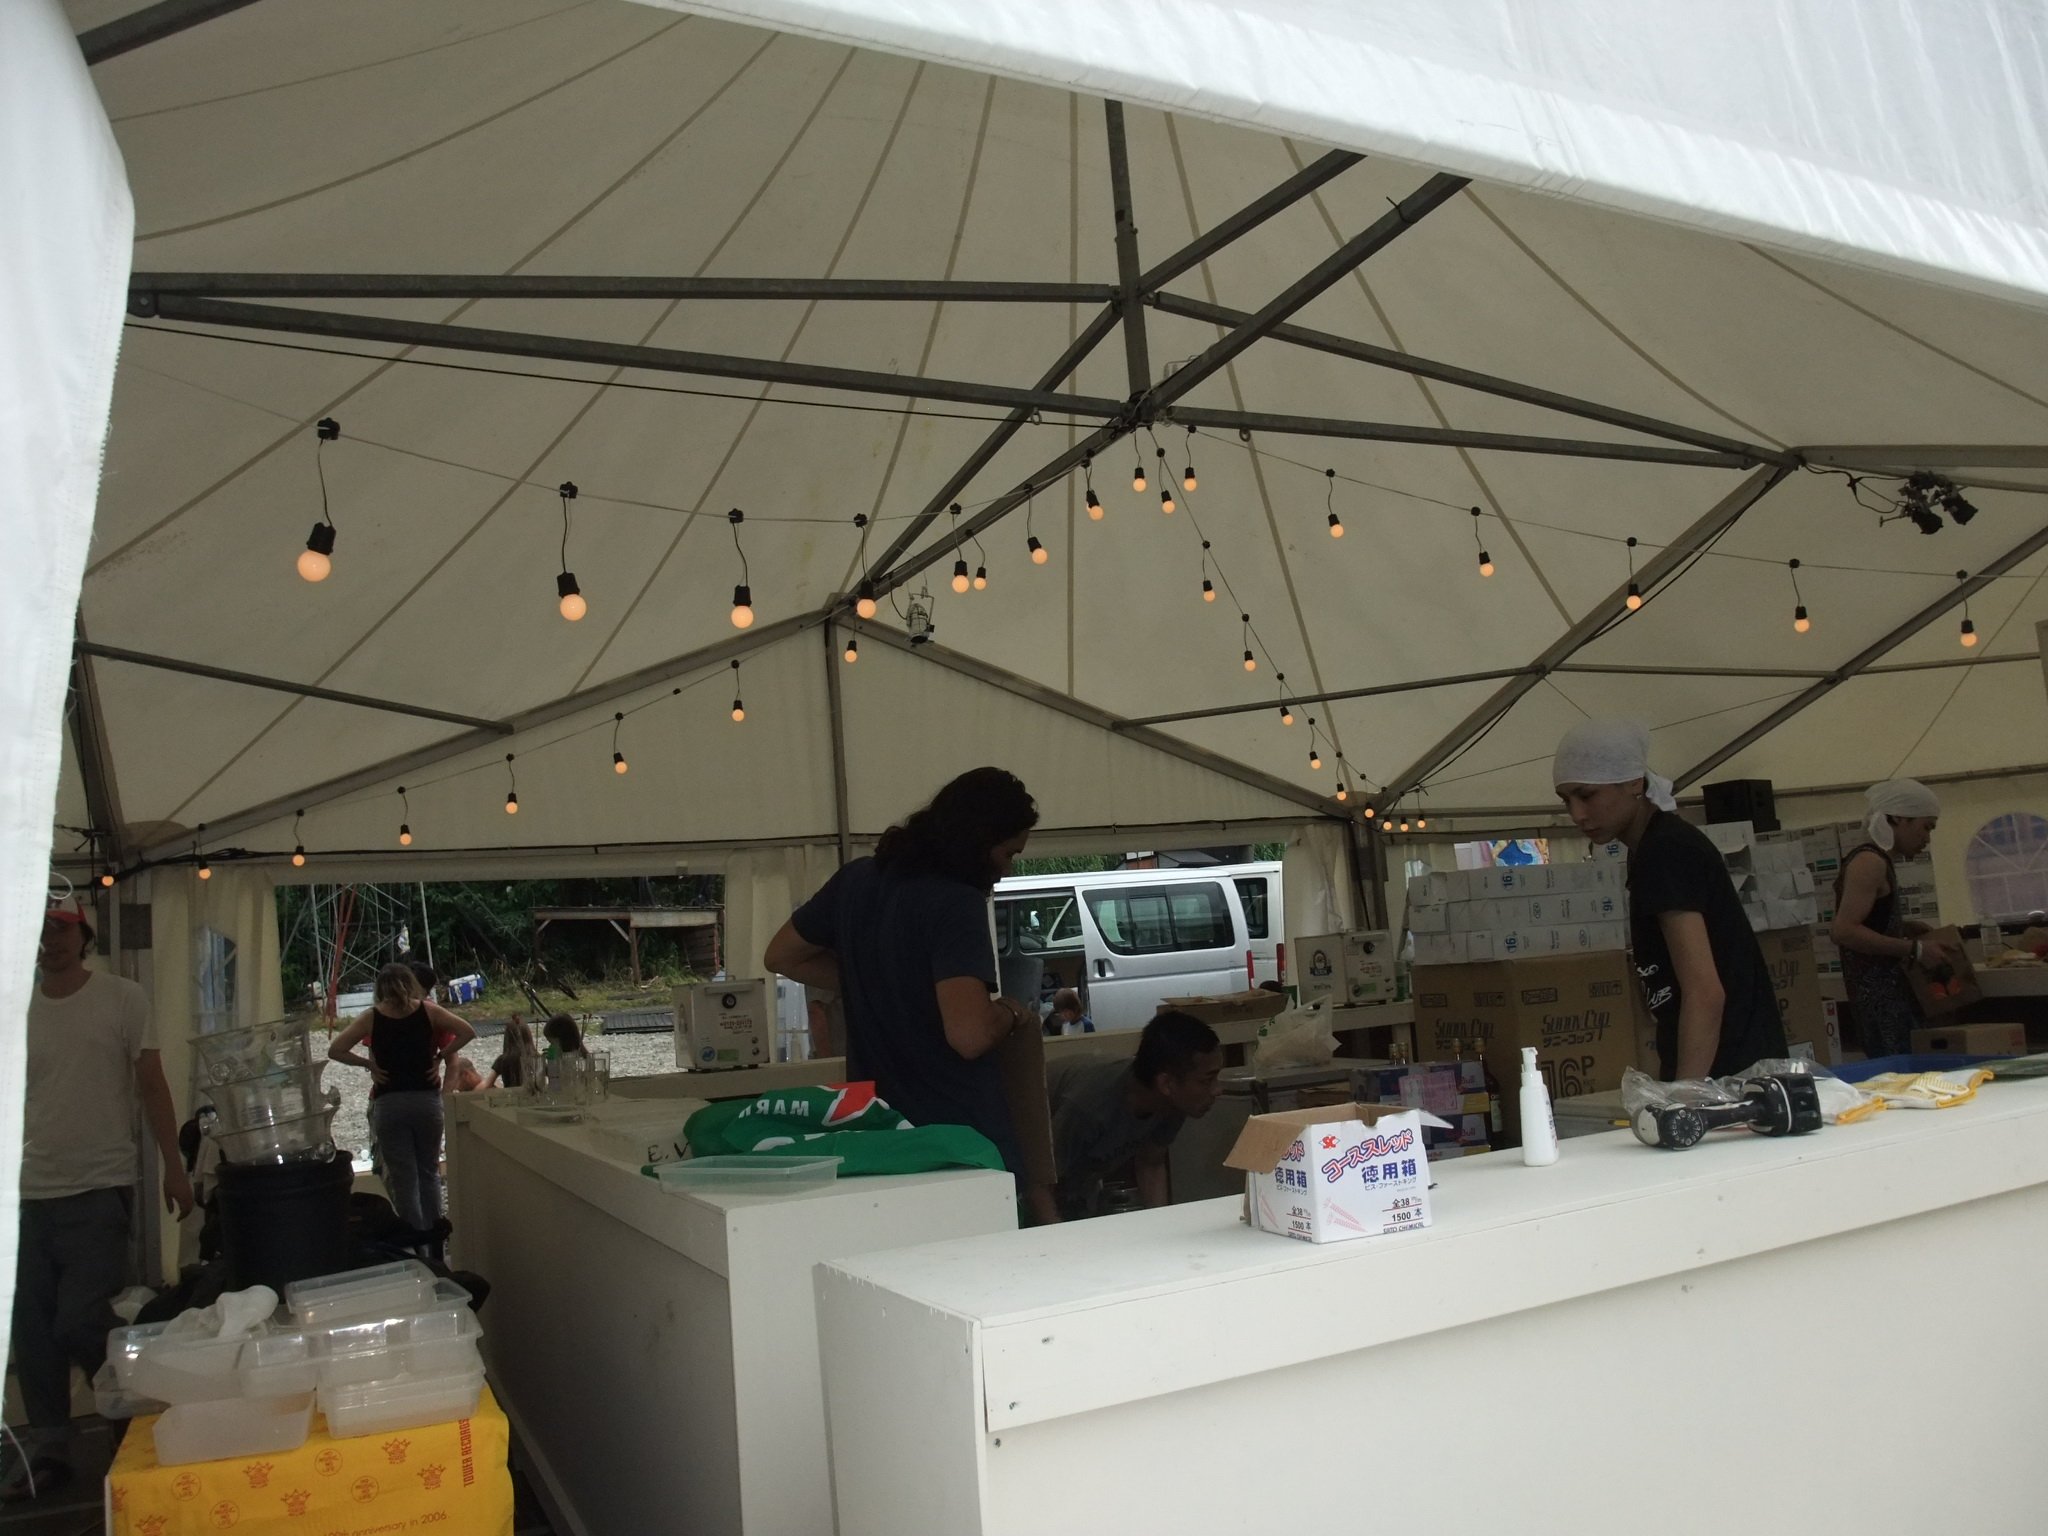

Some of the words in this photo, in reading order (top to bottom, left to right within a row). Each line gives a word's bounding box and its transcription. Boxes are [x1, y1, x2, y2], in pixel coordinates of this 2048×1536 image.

[1322, 1128, 1414, 1183] コーススレッド
[1361, 1158, 1417, 1184] 徳用箱
[1391, 1211, 1412, 1222] 1500
[1414, 1206, 1423, 1217] 本
[457, 1418, 473, 1456] RECORDS
[461, 1456, 475, 1488] TOWER
